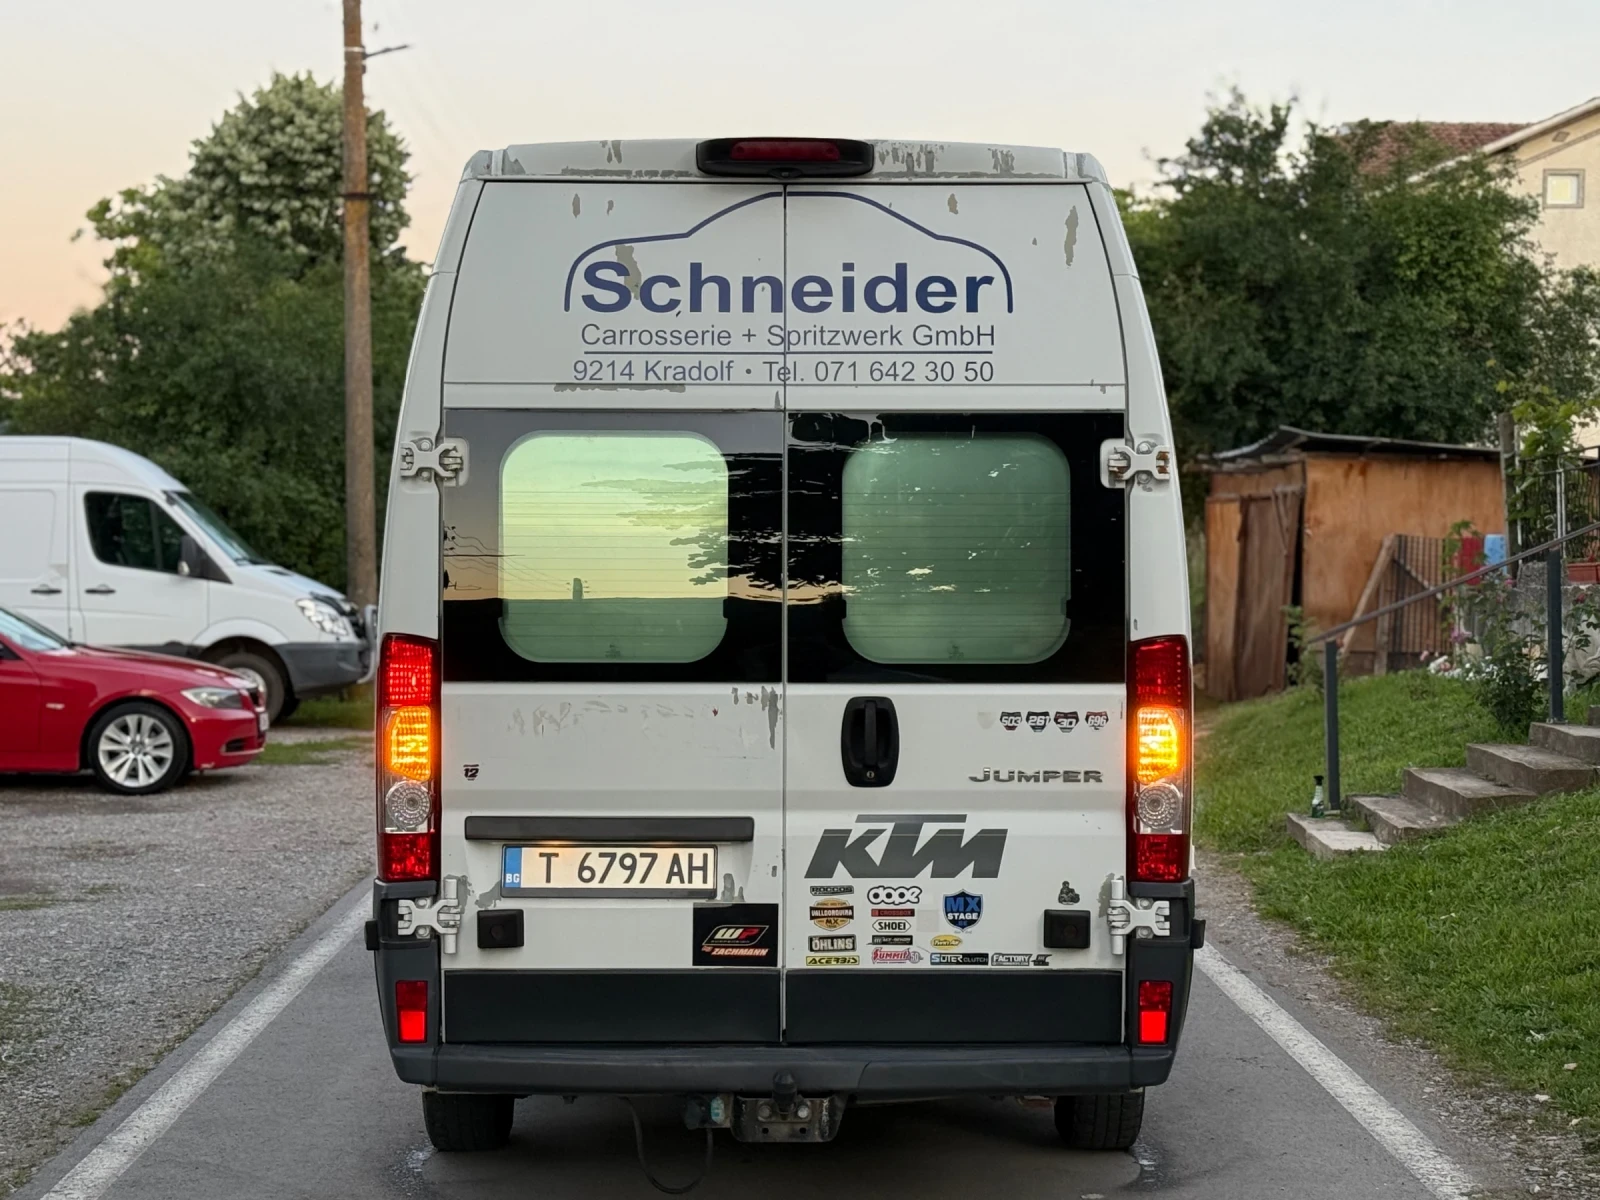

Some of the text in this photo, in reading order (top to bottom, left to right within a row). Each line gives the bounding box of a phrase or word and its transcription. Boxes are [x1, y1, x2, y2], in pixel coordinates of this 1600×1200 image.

[581, 261, 995, 313] Schneider
[581, 324, 995, 351] Carrosserie + Spritzwerk GmbH
[573, 360, 635, 381] 9214
[645, 360, 734, 381] Kradolf
[762, 361, 804, 382] Tel.
[815, 361, 857, 382] 071
[869, 361, 915, 382] 642
[924, 361, 955, 382] 30
[964, 361, 994, 382] 50
[1001, 716, 1021, 726] 503
[1028, 715, 1050, 726] 261
[1057, 718, 1077, 728] 30
[1088, 715, 1107, 727] 696
[464, 768, 480, 778] 12
[968, 767, 1103, 783] JUMPER
[804, 814, 1008, 879] KTM
[538, 852, 709, 884] T 6797 AH
[505, 873, 520, 883] BG
[867, 885, 923, 905] dope
[946, 896, 980, 912] MX
[947, 912, 979, 920] STAGE
[825, 918, 841, 926] MX
[877, 921, 906, 930] SHOEI
[713, 928, 759, 940] WP
[812, 937, 854, 950] ÖHLINS
[711, 947, 769, 956] ZACHMANN
[808, 957, 858, 965] ACERBIS
[993, 954, 1029, 962] FACTORY
